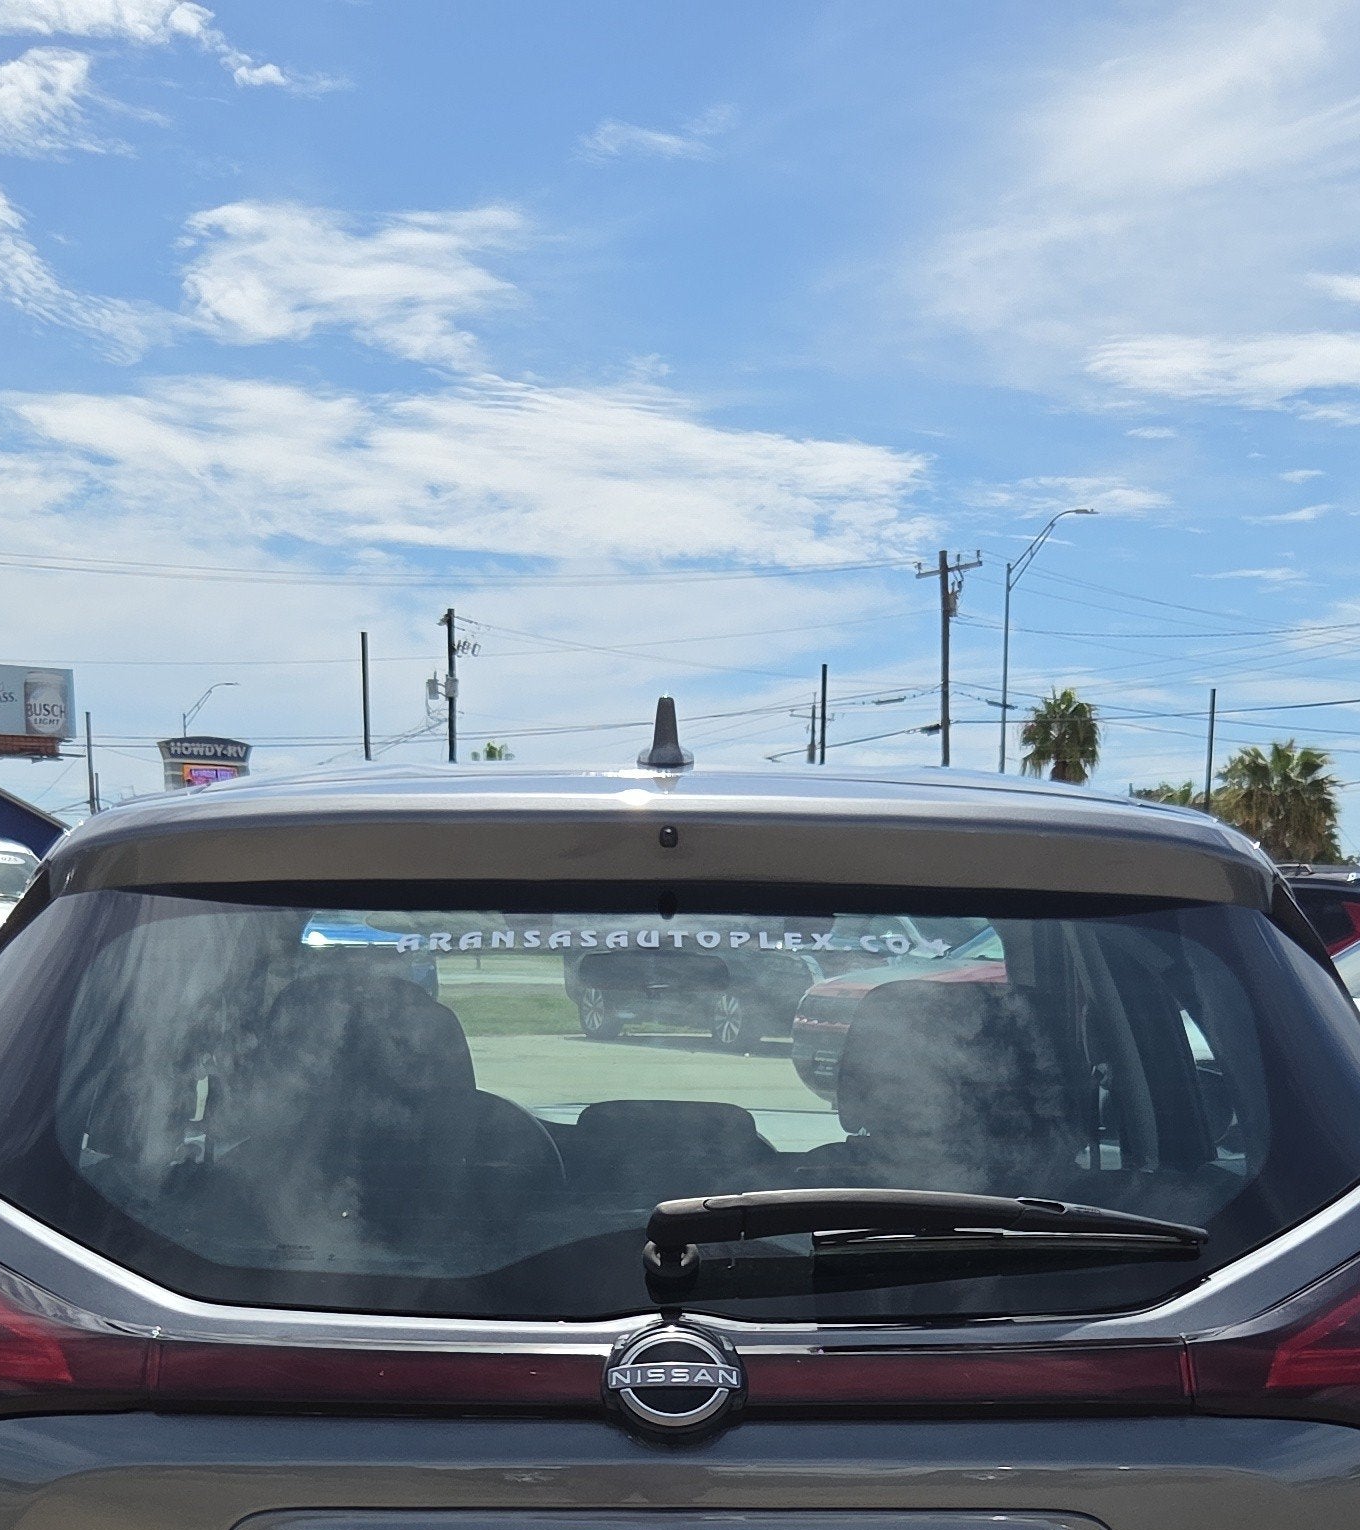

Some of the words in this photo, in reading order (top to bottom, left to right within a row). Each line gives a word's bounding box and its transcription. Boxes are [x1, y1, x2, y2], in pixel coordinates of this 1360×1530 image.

[25, 703, 66, 718] BUSCH
[34, 717, 59, 725] LIGHT
[612, 1368, 738, 1385] NISSAN
